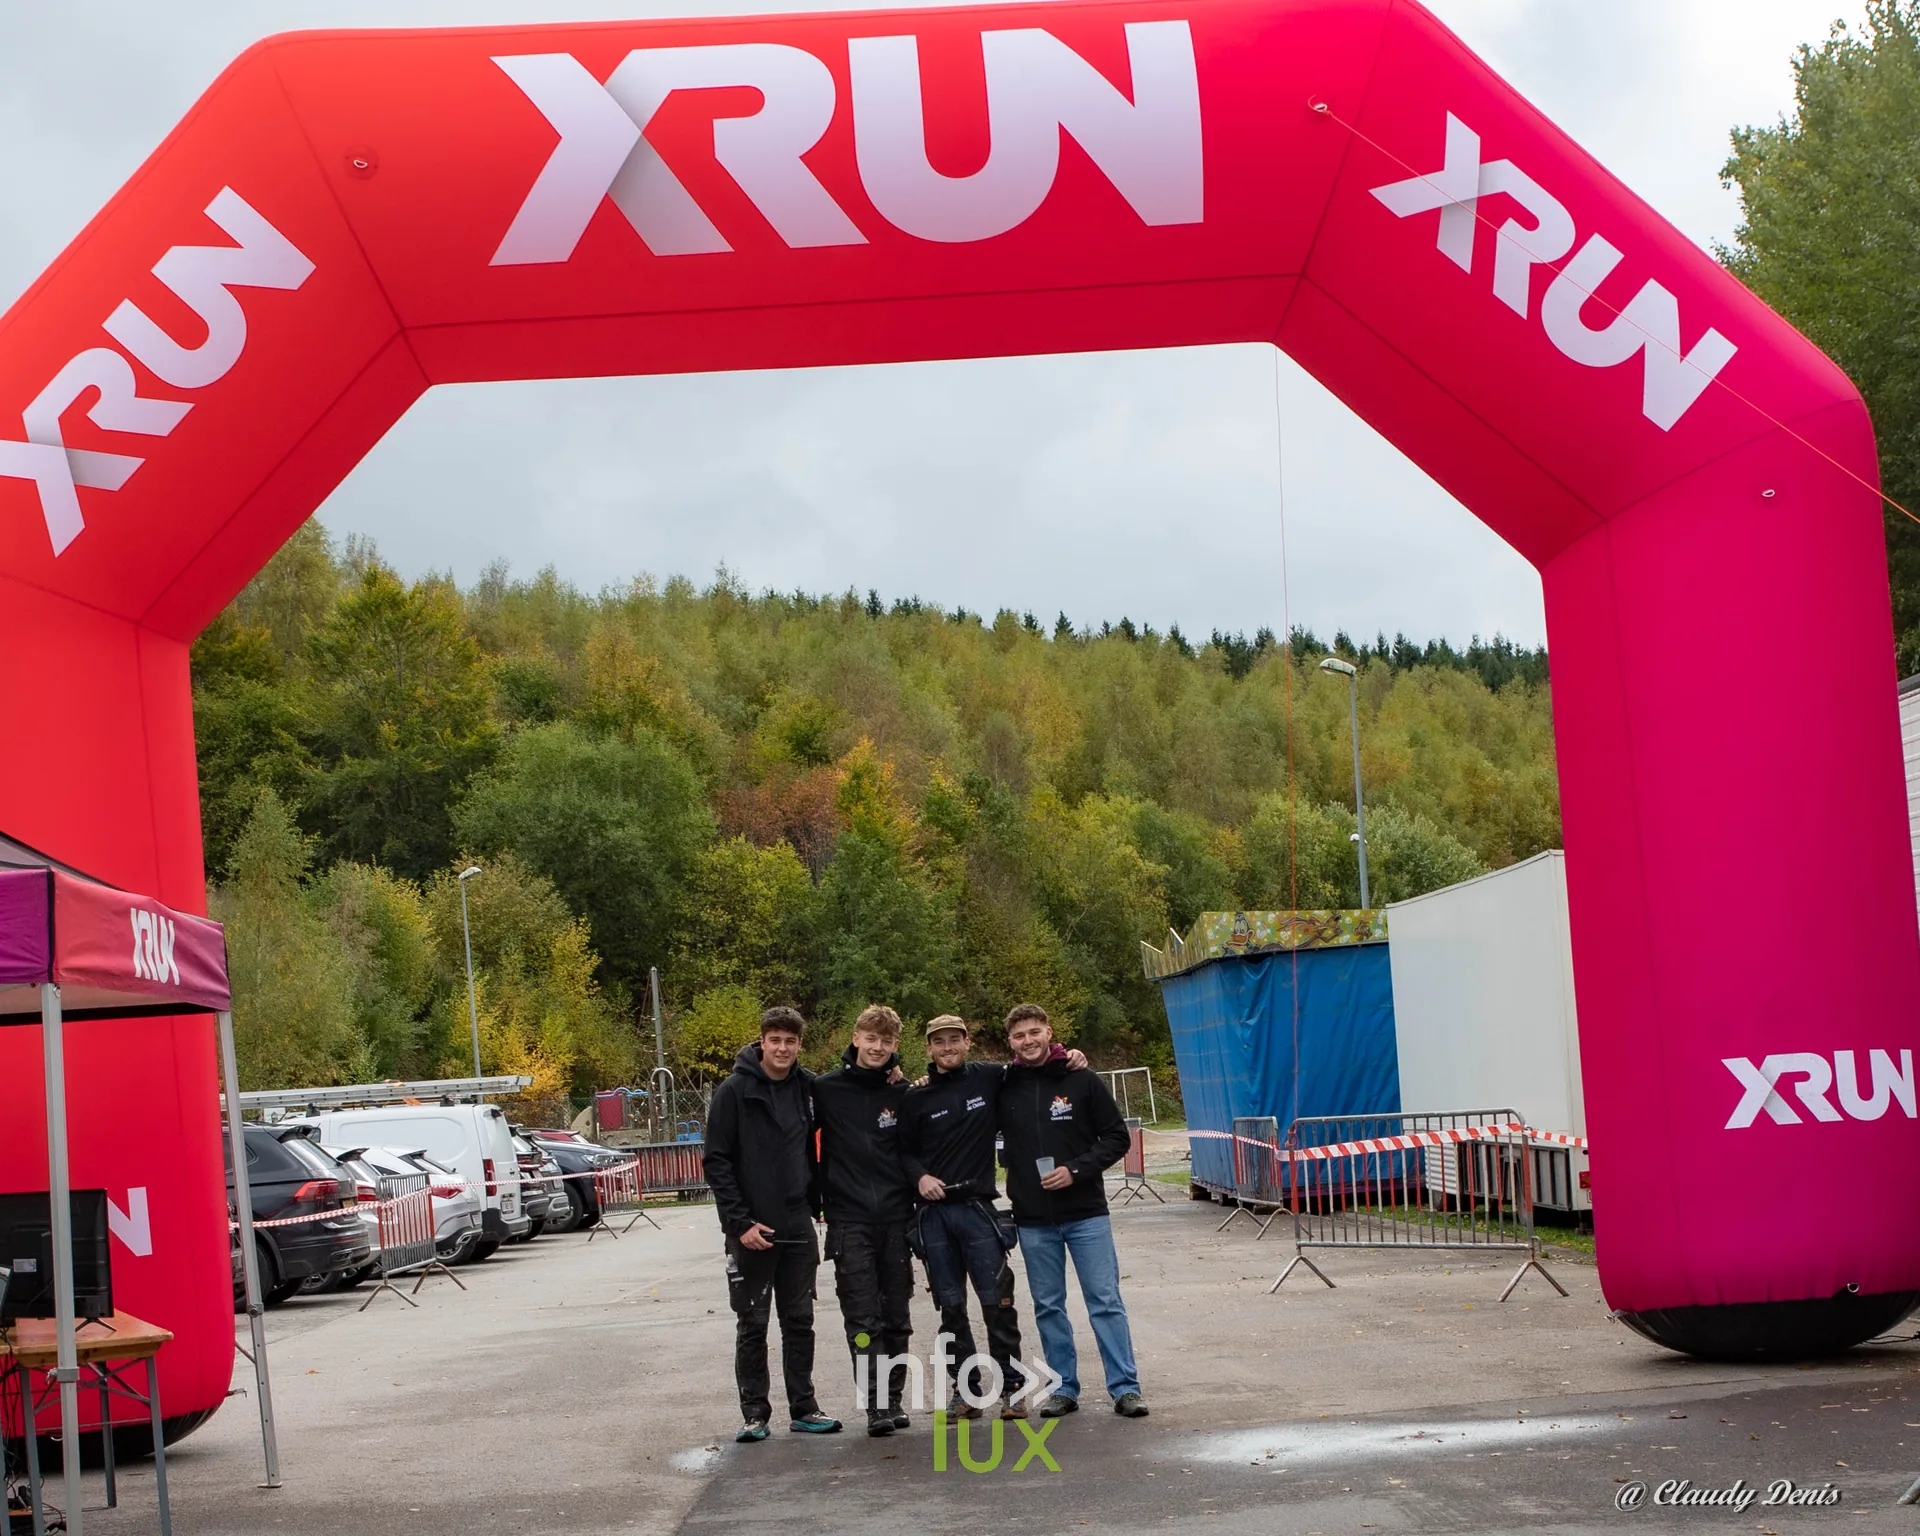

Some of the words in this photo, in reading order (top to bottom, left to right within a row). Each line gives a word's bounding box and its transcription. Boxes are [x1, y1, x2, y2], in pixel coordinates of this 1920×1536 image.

[489, 20, 1204, 265] XRUN
[0, 185, 317, 558] XRUN
[1368, 110, 1738, 432] XRUN
[130, 907, 181, 986] XRUN
[1721, 1049, 1918, 1130] XRUN
